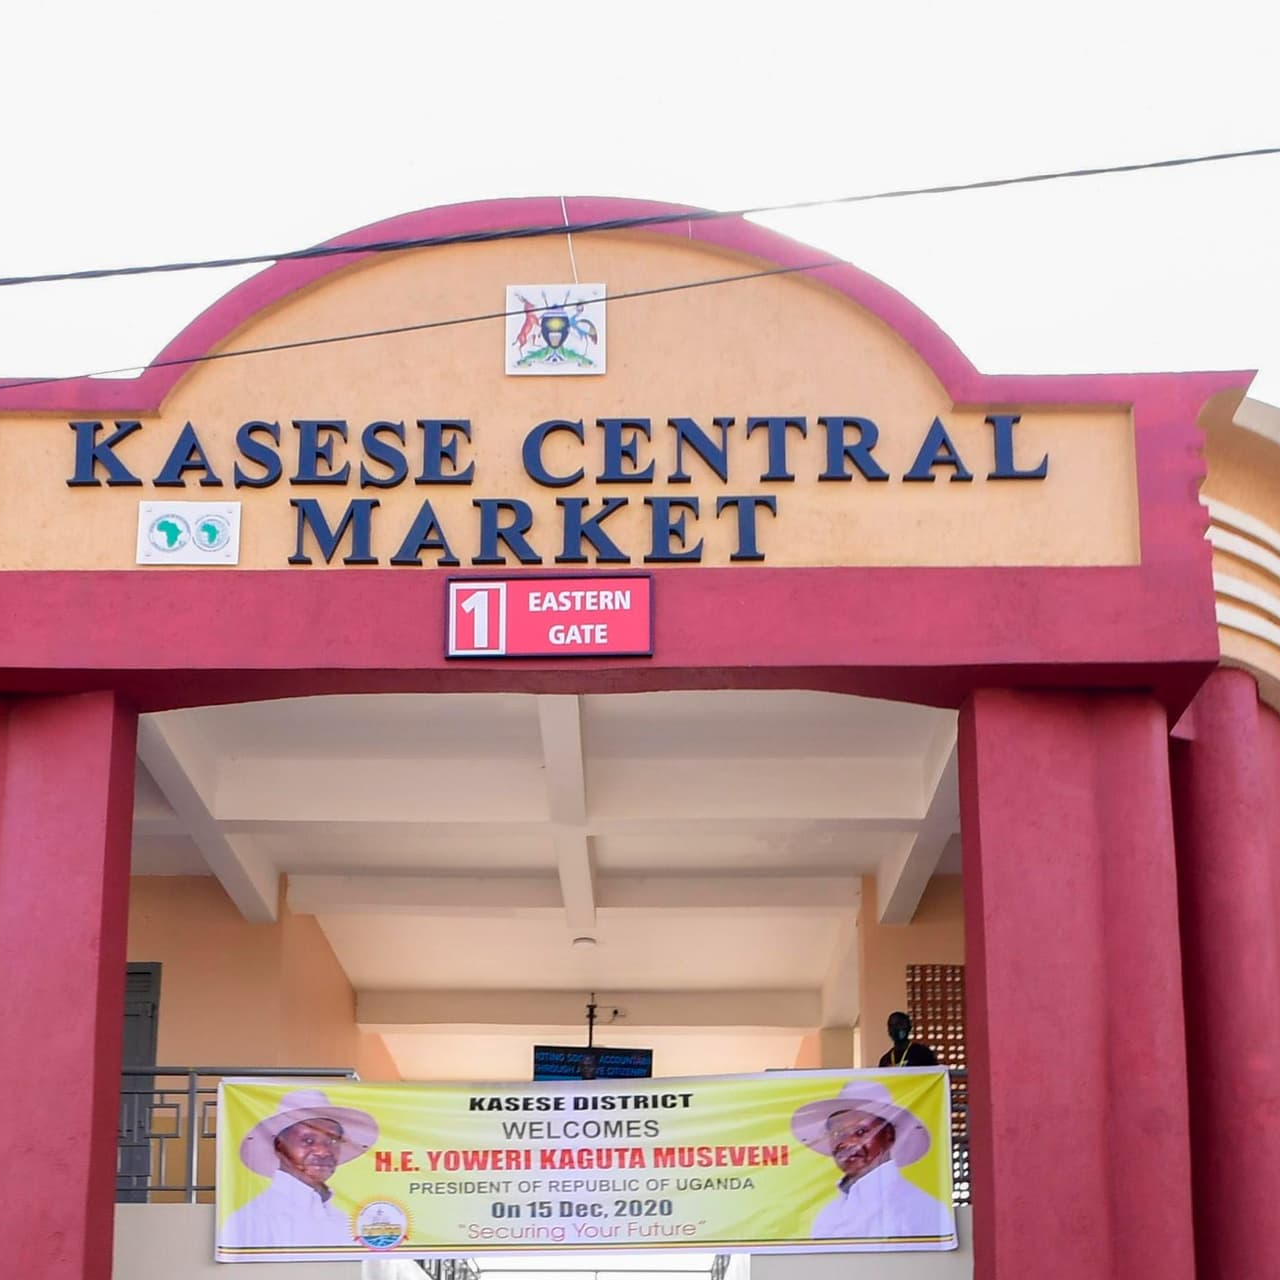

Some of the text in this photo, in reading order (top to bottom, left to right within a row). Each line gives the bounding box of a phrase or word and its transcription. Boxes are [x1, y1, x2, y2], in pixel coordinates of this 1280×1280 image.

[66, 415, 1048, 489] KASESE CENTRAL
[288, 496, 776, 566] MARKET
[528, 590, 631, 612] EASTERN
[460, 590, 489, 649] 1
[548, 624, 608, 645] GATE
[469, 1093, 693, 1111] KASESE DISTRICT
[502, 1120, 660, 1139] WELCOMES
[375, 1145, 790, 1172] H.E. YOWERI KAGUTA MUSEVENI
[409, 1177, 754, 1194] PRESIDENT OF REPUBLIC OF UGANDA
[492, 1200, 673, 1218] On 15 Dec, 2020
[573, 1222, 621, 1238] Your
